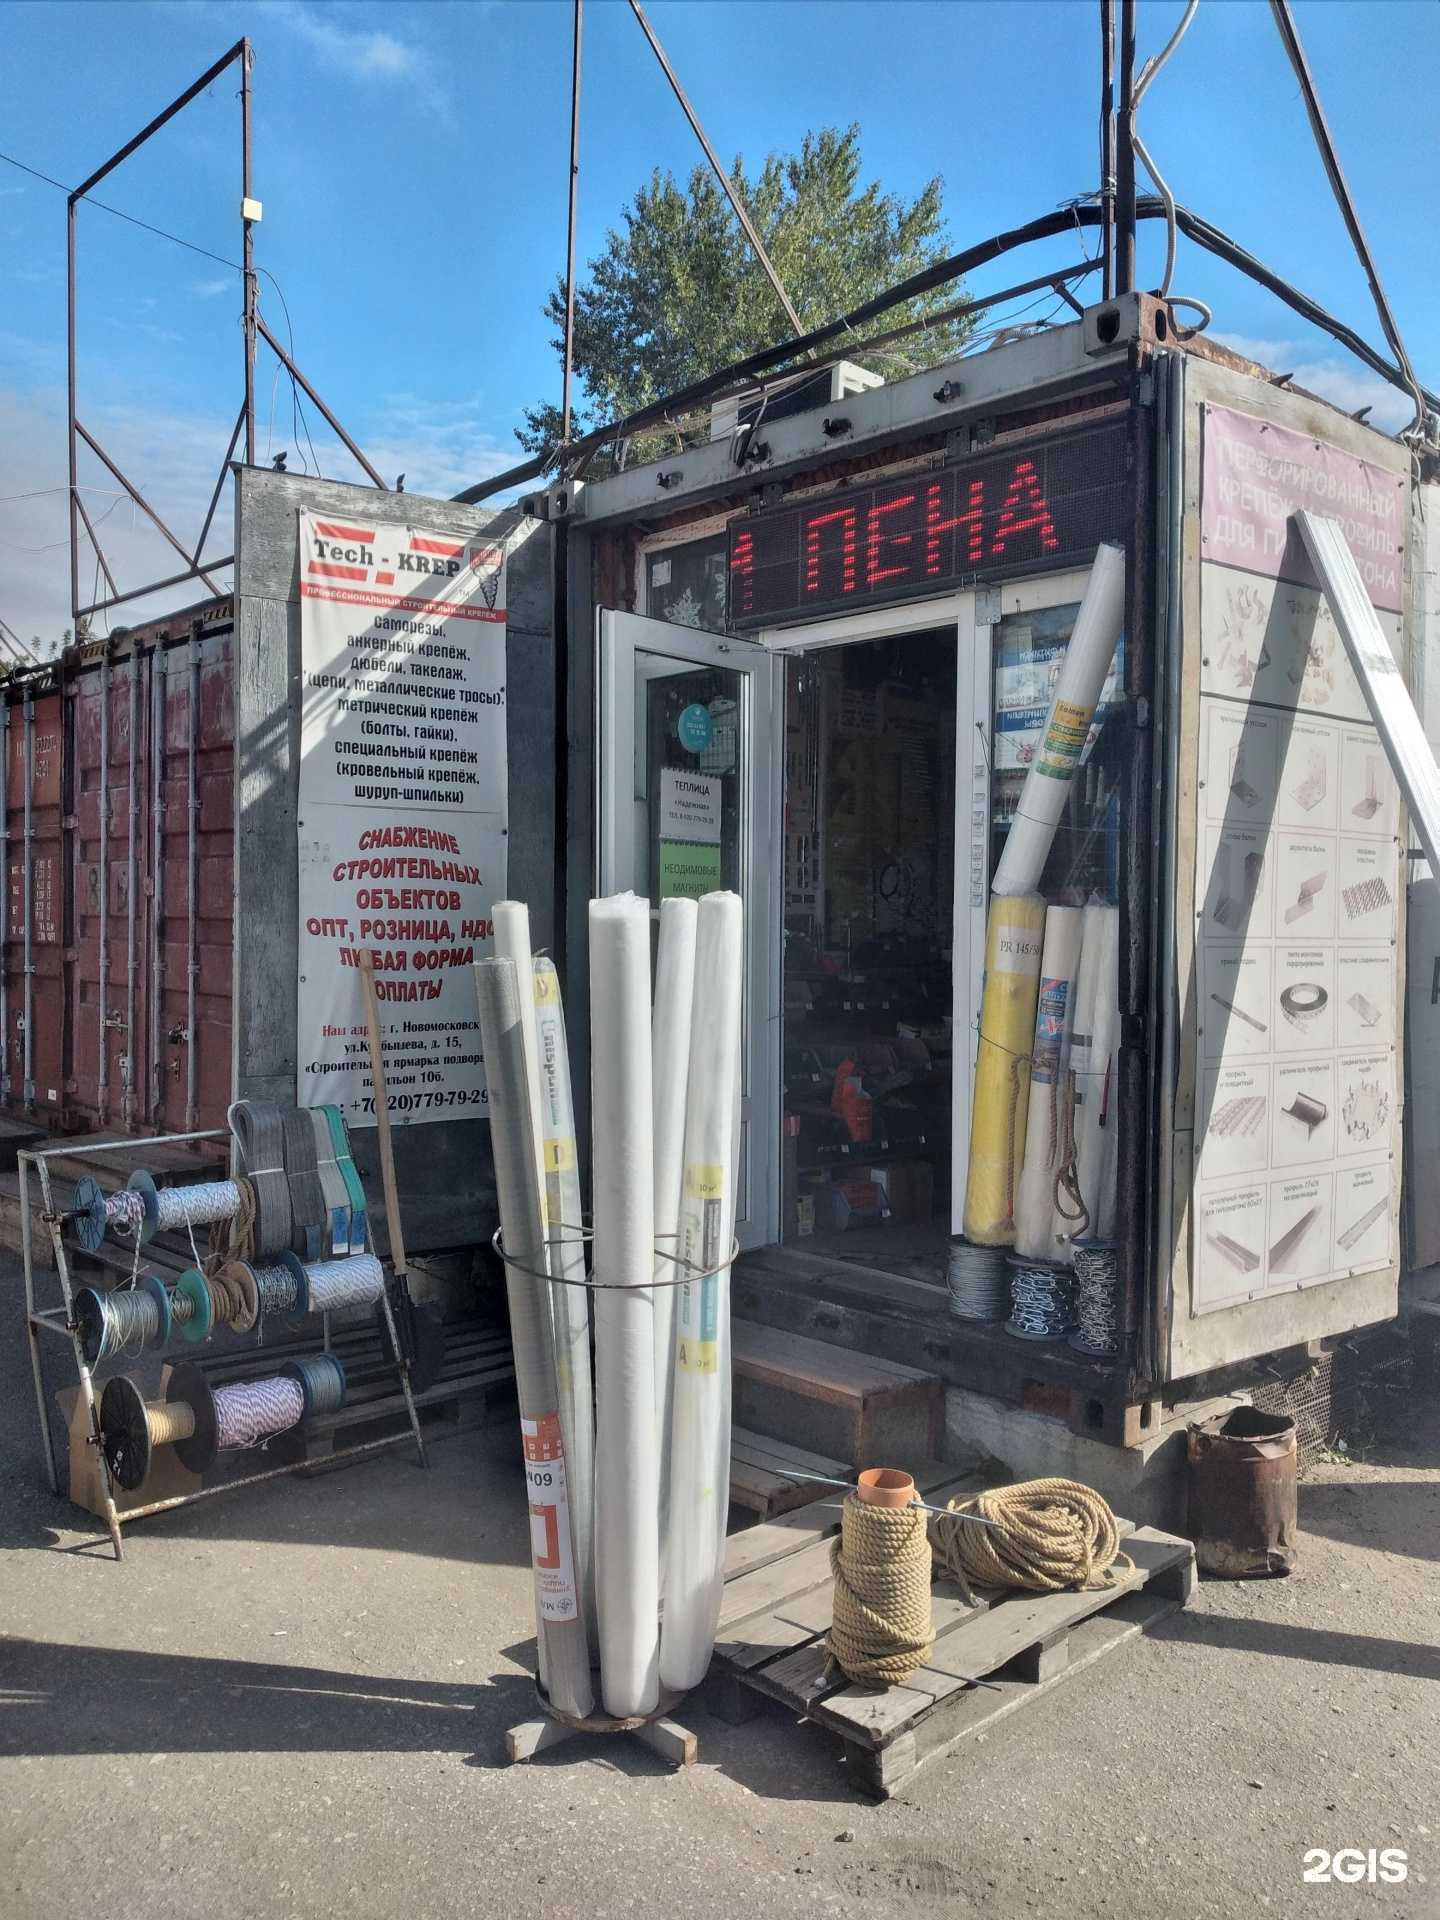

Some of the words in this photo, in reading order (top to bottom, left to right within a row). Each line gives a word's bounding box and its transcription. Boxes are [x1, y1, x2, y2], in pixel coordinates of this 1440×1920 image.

[807, 462, 1059, 592] ПЕНА
[1214, 515, 1256, 550] ДЛЯ
[313, 538, 374, 566] Tech
[397, 552, 461, 578] KREP
[346, 634, 415, 654] анкерный
[354, 678, 456, 701] металлические
[337, 698, 427, 719] метрический
[335, 740, 426, 760] специальный
[429, 748, 478, 765] крепёж
[336, 760, 425, 781] (кровельный
[354, 785, 464, 804] шуруп-шпильки)
[674, 780, 711, 796] ТЕПЛИЦА
[358, 826, 461, 855] СНАБЖЕНИЕ
[333, 857, 483, 886] СТРОИТЕЛЬНЫХ
[664, 862, 718, 878] НЕОДИМОВЫЕ
[356, 888, 462, 911] ОБЪЕКТОВ
[306, 918, 355, 943] ОПТ,
[360, 919, 456, 943] РОЗНИЦА,
[1000, 940, 1013, 952] PR
[412, 946, 474, 971] ФОРМА
[375, 978, 444, 1002] ОПЛАТЫ
[322, 1024, 346, 1037] Наш
[350, 1025, 385, 1037] адр:
[344, 1038, 428, 1056] ул.Кбышева,
[305, 1058, 390, 1075] «Строителья
[393, 1057, 440, 1070] ярмарка
[362, 1074, 416, 1087] паильон
[351, 1088, 488, 1114] +7(20)779-79-29
